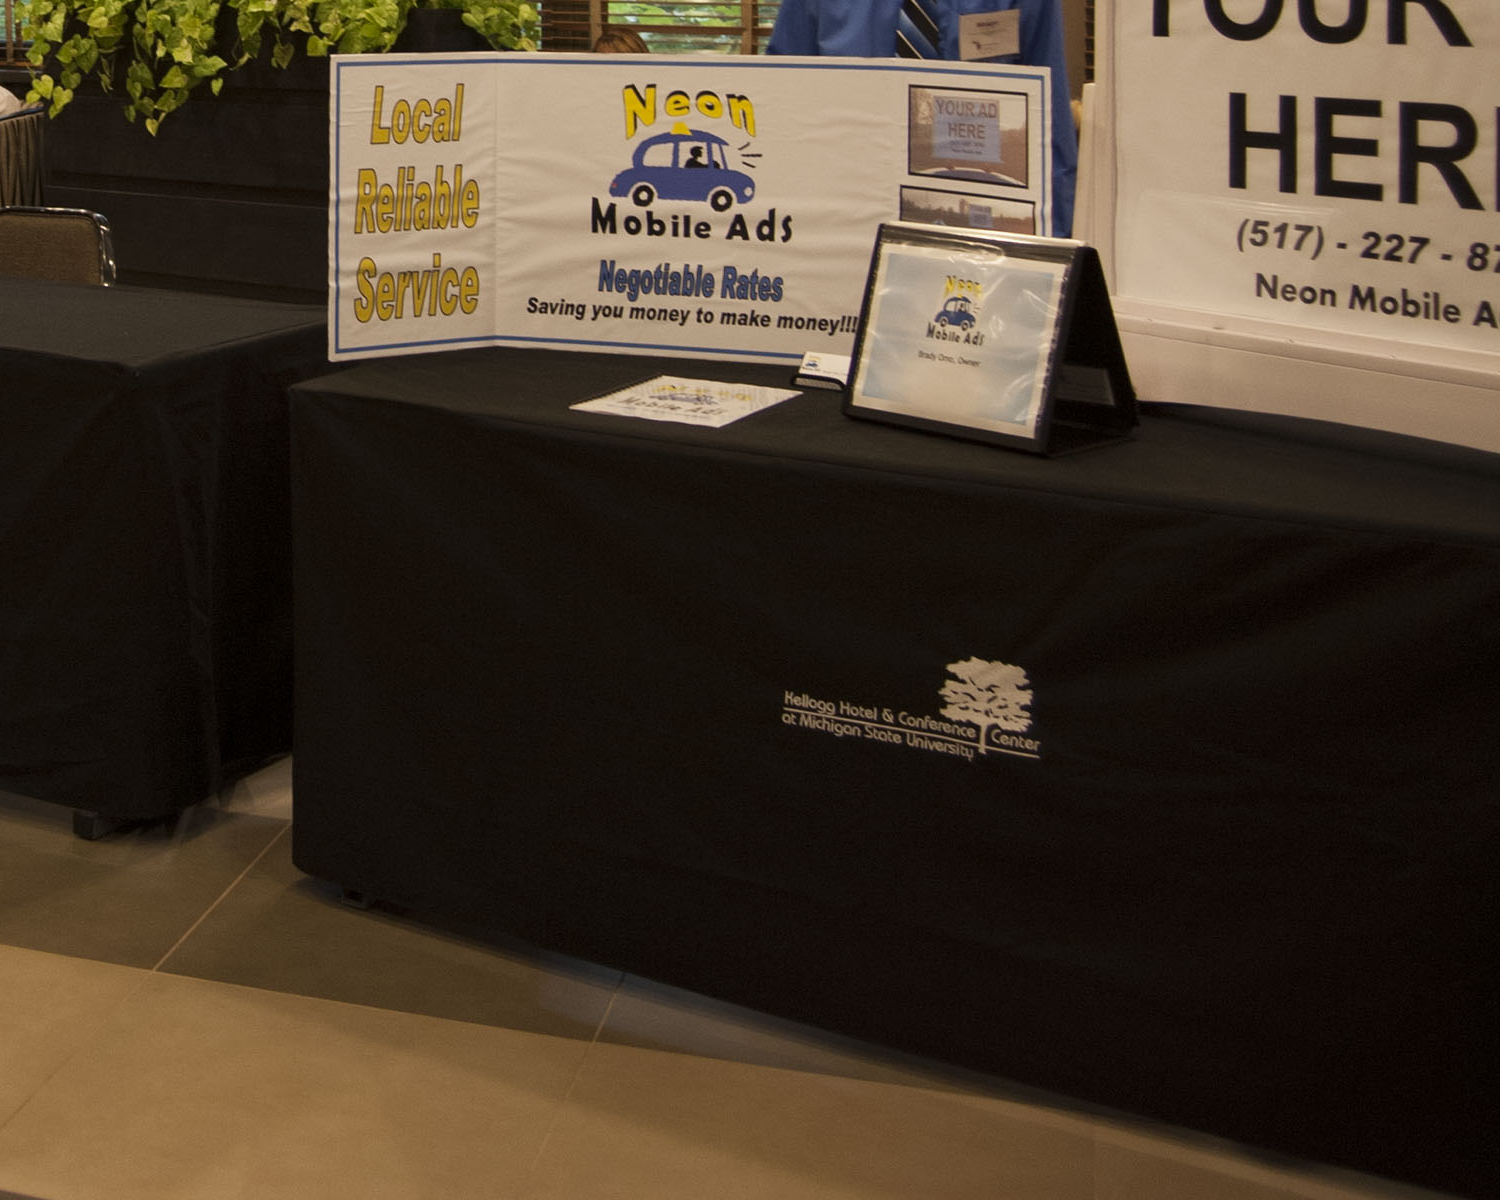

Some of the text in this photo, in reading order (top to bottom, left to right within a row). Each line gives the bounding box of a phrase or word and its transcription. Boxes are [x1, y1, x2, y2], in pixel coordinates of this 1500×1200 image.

[370, 83, 464, 145] Local
[622, 84, 756, 140] Neon
[935, 99, 997, 118] YOUR AD
[948, 122, 985, 139] HERE
[1229, 92, 1500, 212] HER
[354, 164, 480, 234] Reliable
[591, 197, 792, 243] Mobile Ads
[1237, 218, 1324, 261] (517)
[1360, 231, 1430, 264] 227
[354, 253, 479, 323] Service
[598, 259, 784, 302] Negotiable Rates
[944, 275, 983, 299] Neon
[1254, 272, 1337, 307] Neon
[1348, 283, 1461, 323] Mobile
[527, 297, 858, 334] Saving you money to make money!!!
[926, 322, 985, 346] Mobile Ads
[781, 713, 975, 762] at Michigan State University
[783, 690, 1041, 752] Kellogg Hotel & Conference Center
